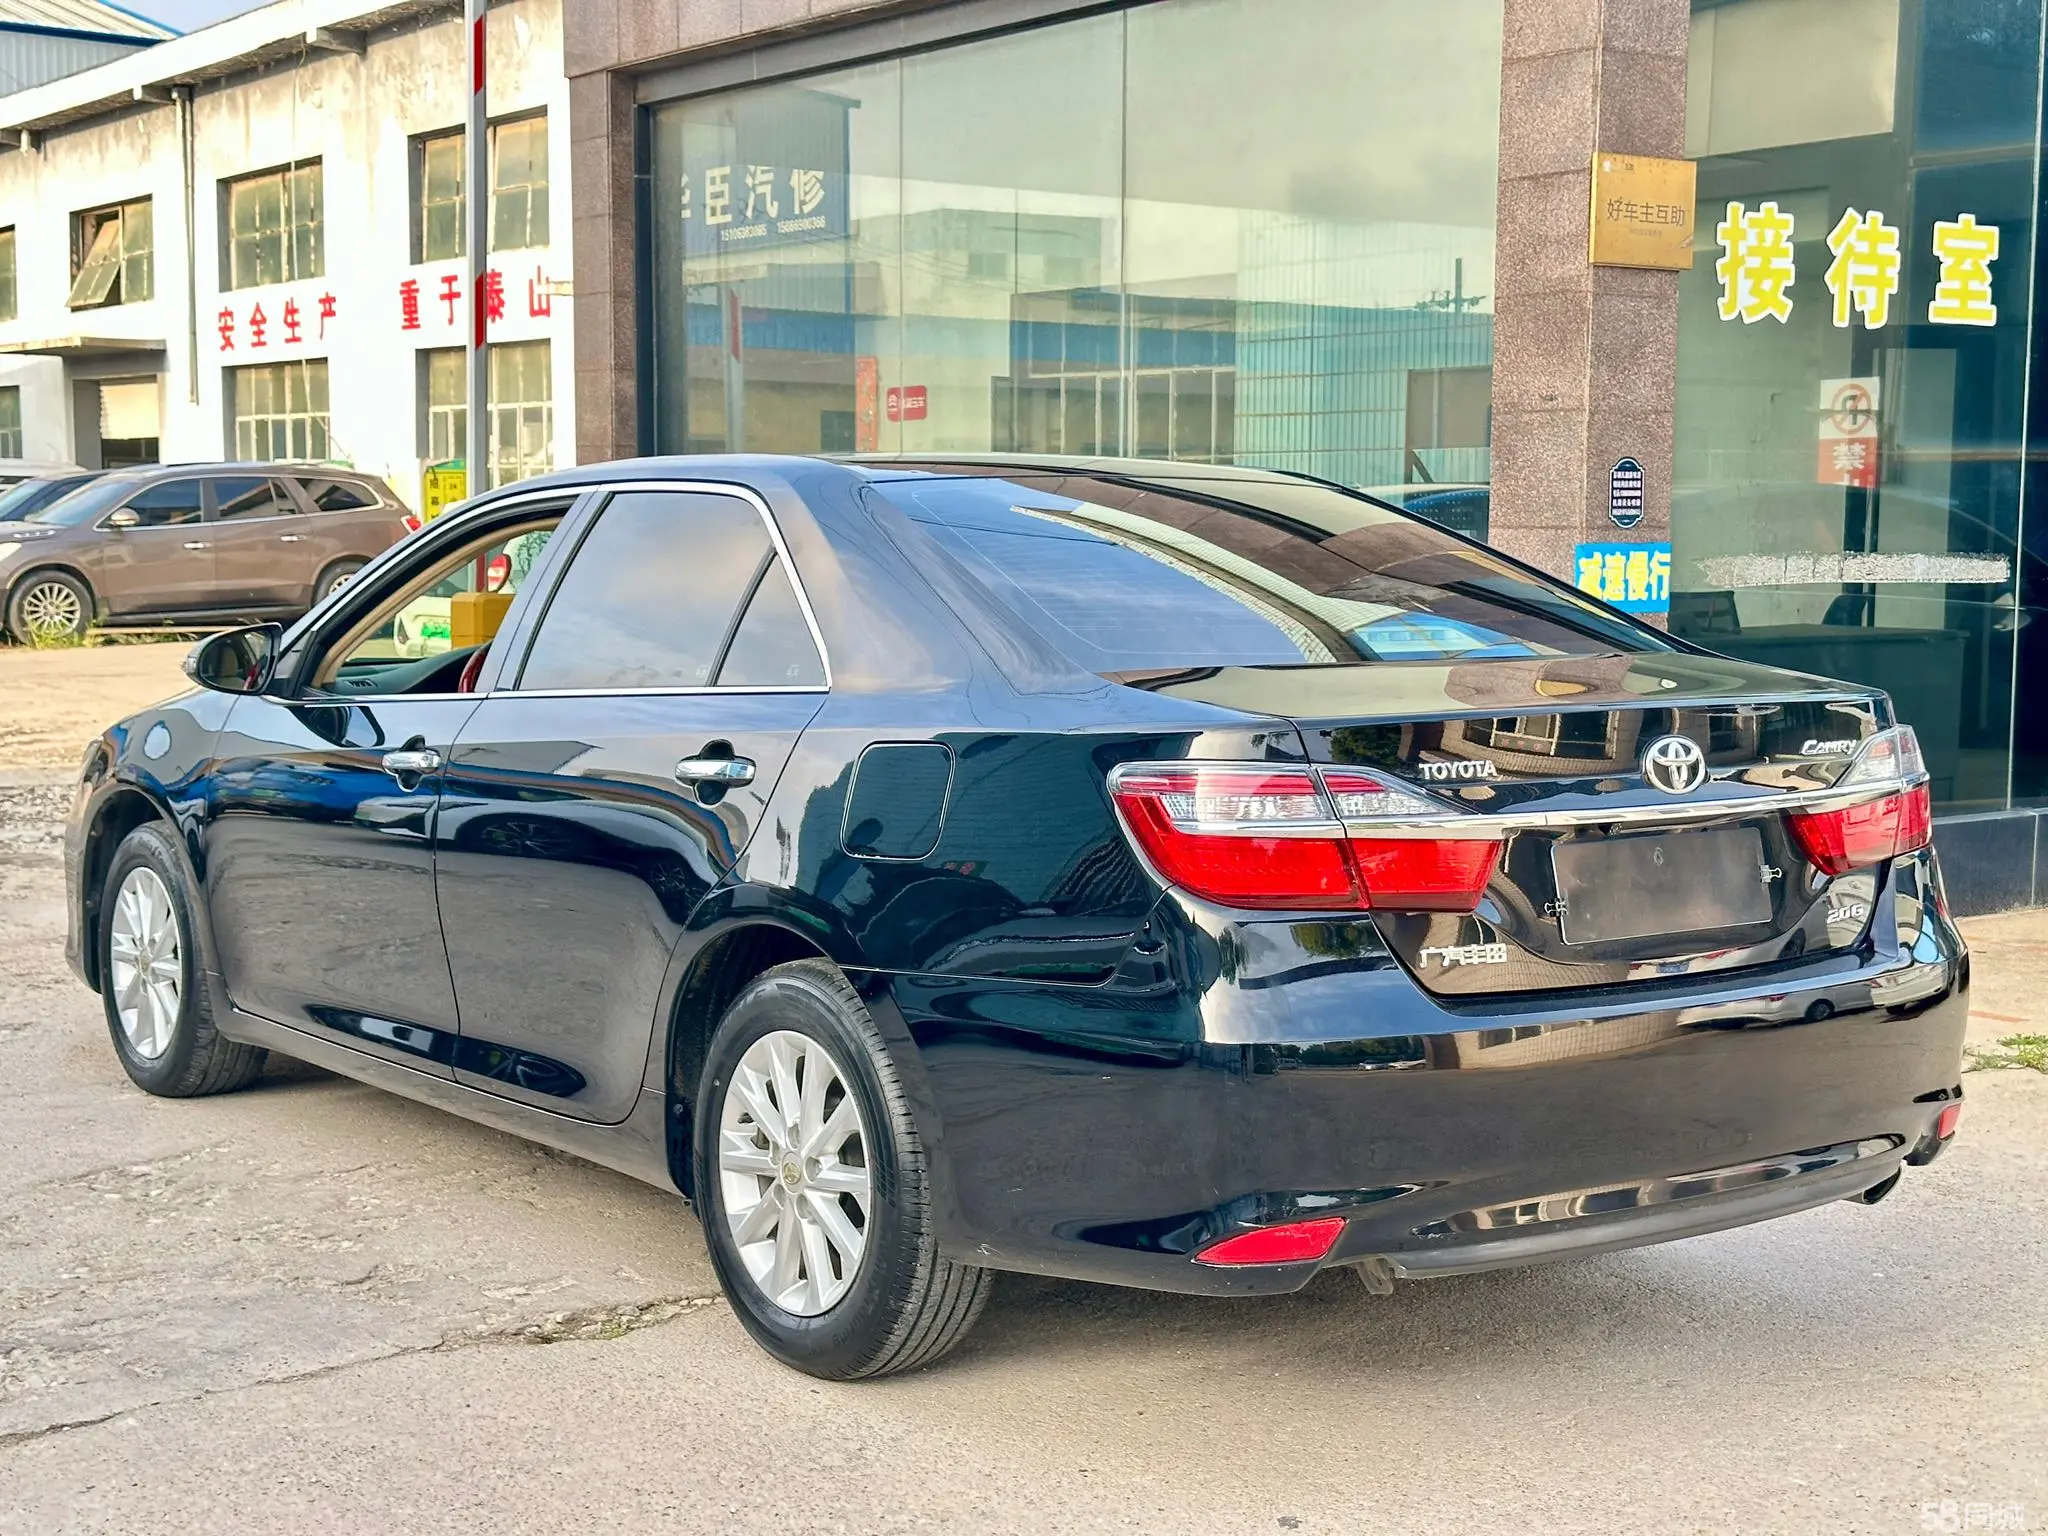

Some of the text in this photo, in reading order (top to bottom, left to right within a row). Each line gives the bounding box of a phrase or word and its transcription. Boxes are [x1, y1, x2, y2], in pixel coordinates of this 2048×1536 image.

[1607, 197, 1685, 226] 好车主互助
[1715, 201, 1999, 329] 接待室
[218, 266, 550, 351] 安全生产 重于泰山
[1578, 551, 1671, 601] 减速慢行
[1419, 760, 1498, 780] TOYOTA
[1420, 943, 1508, 968] 广汽丰田
